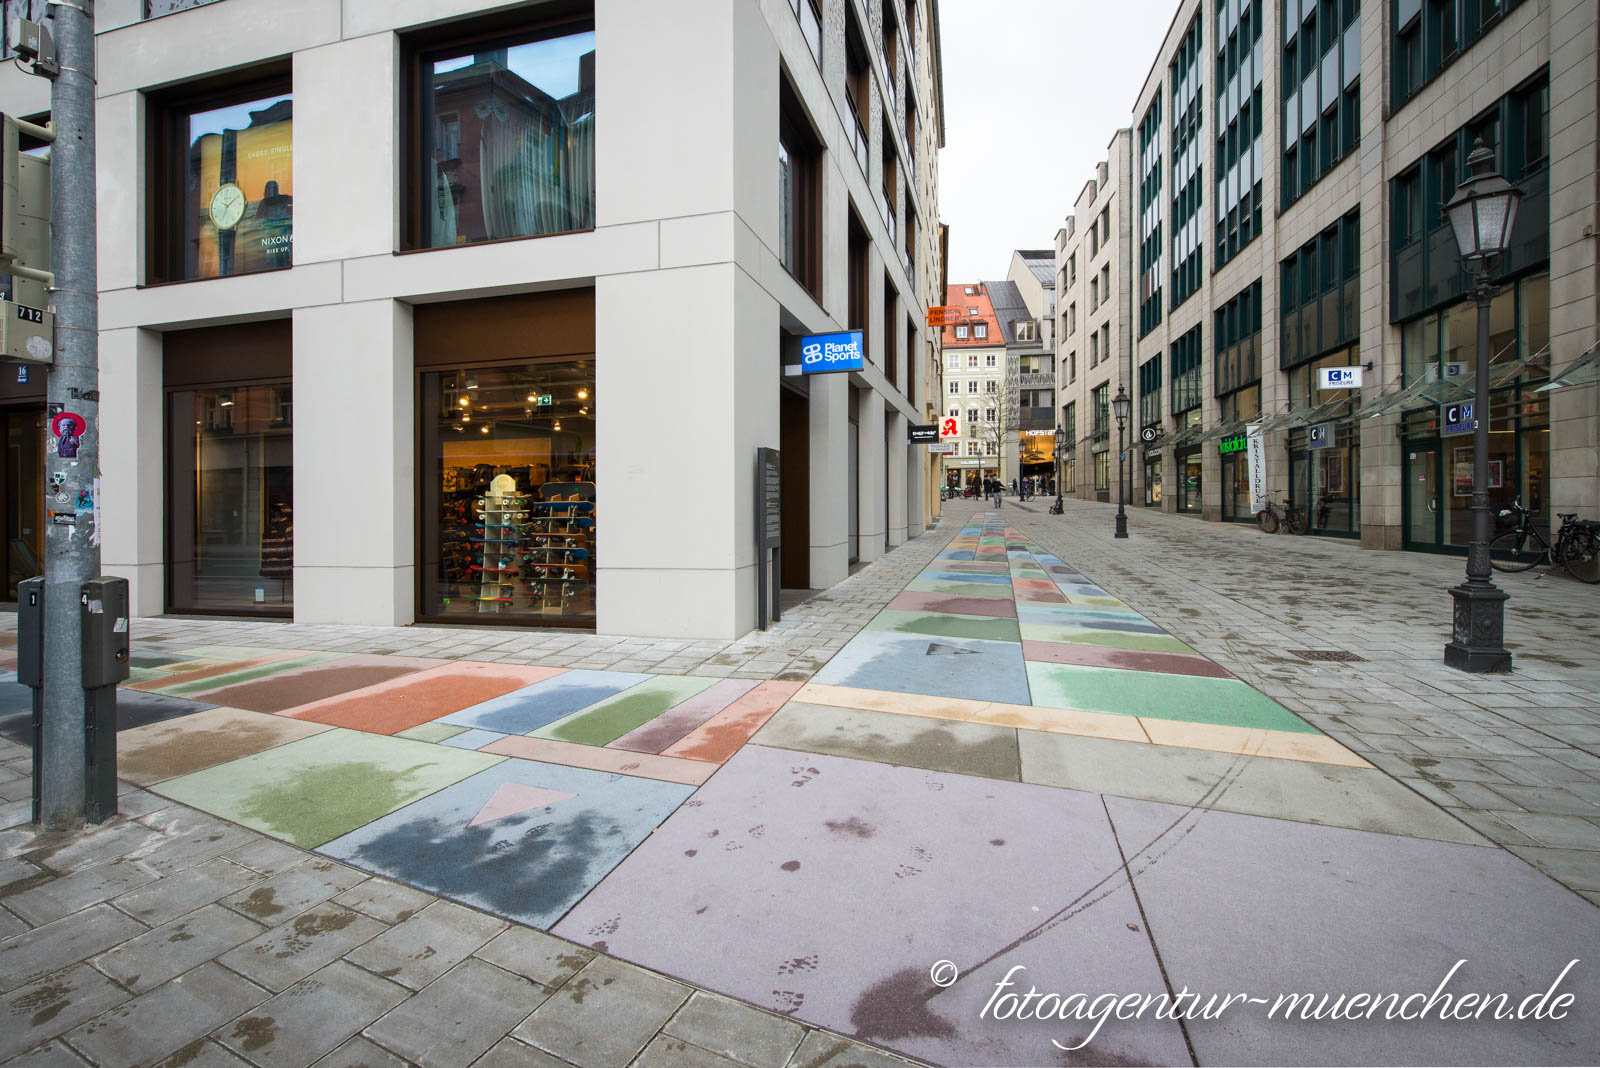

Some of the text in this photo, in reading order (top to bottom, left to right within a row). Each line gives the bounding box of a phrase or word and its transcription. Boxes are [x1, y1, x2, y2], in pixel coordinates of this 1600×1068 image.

[261, 235, 289, 246] NIXON
[19, 307, 42, 321] 712
[824, 341, 858, 353] Planet
[824, 350, 861, 364] Sports
[82, 594, 88, 605] 4
